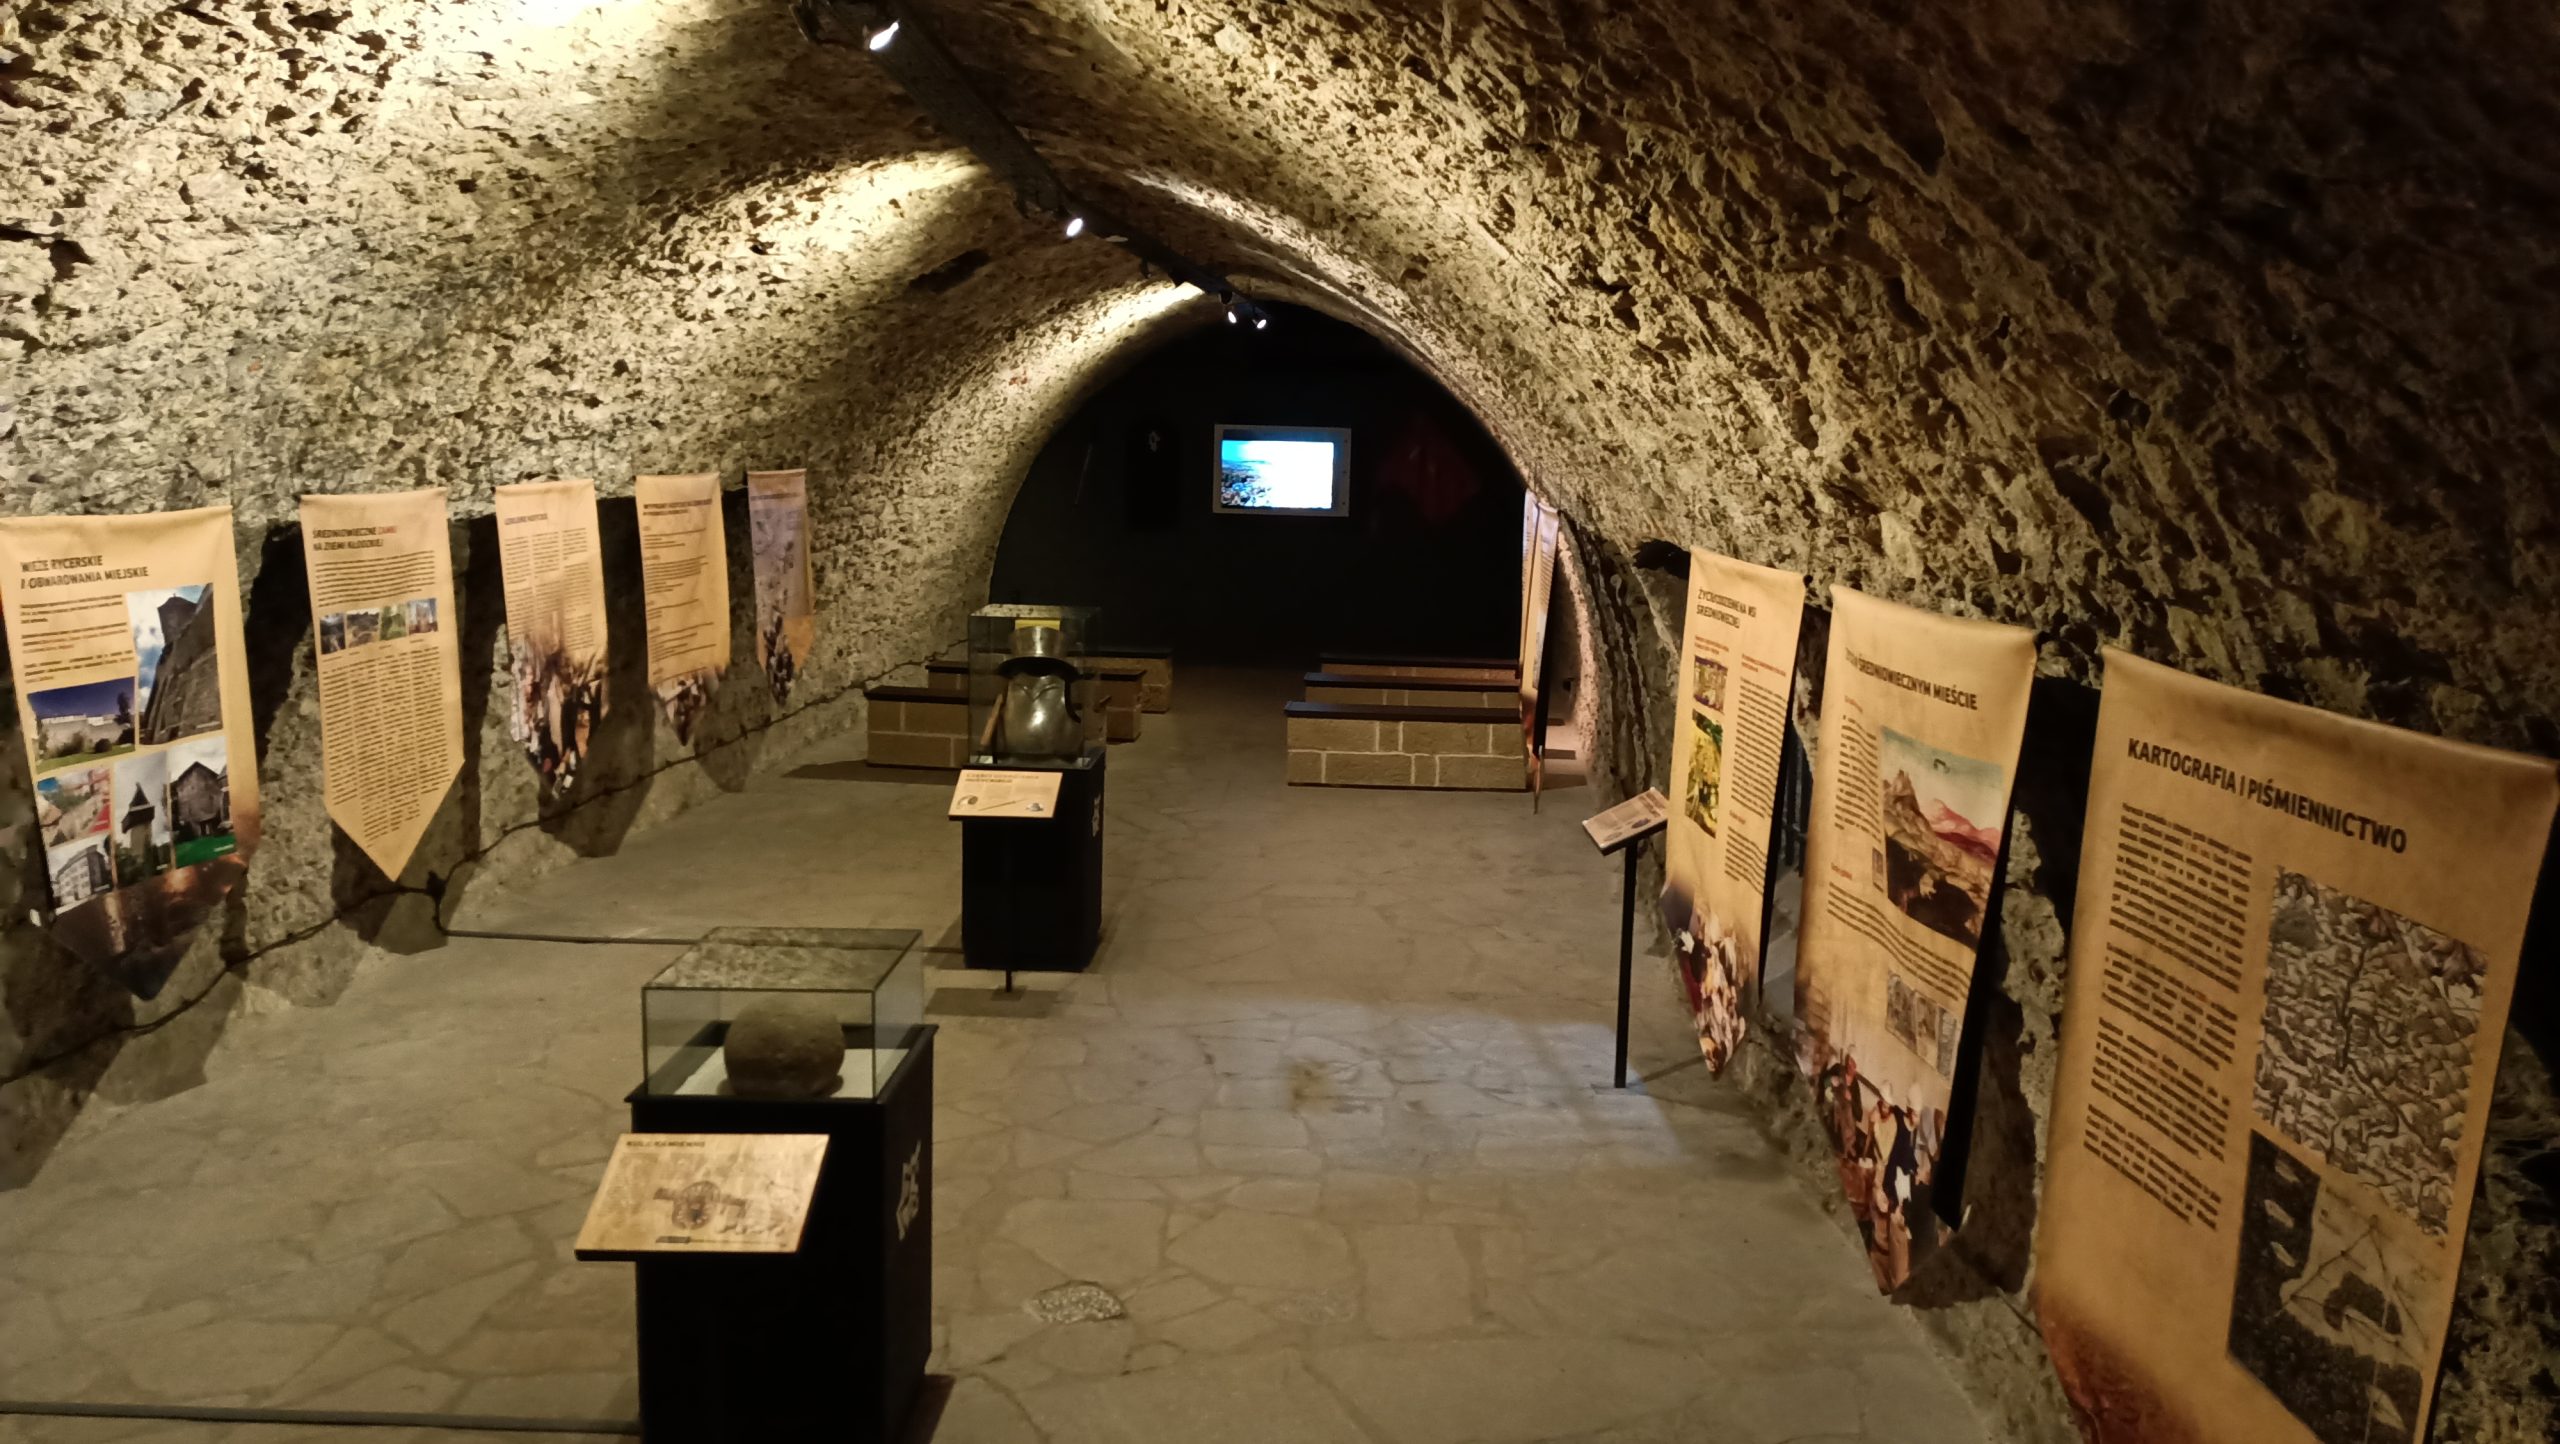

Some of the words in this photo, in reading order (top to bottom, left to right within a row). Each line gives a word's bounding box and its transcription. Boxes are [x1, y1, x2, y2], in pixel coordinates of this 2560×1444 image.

[51, 555, 103, 569] RYCERSKIE
[28, 572, 102, 589] OBWAROWANIA
[104, 566, 149, 580] MIEJSKIE
[1933, 684, 1978, 710] MIEŚCIE
[2127, 738, 2236, 795] KARTOGRAFIA
[2239, 775, 2246, 797] I
[2248, 778, 2408, 854] PIŚMIENNICTWO
